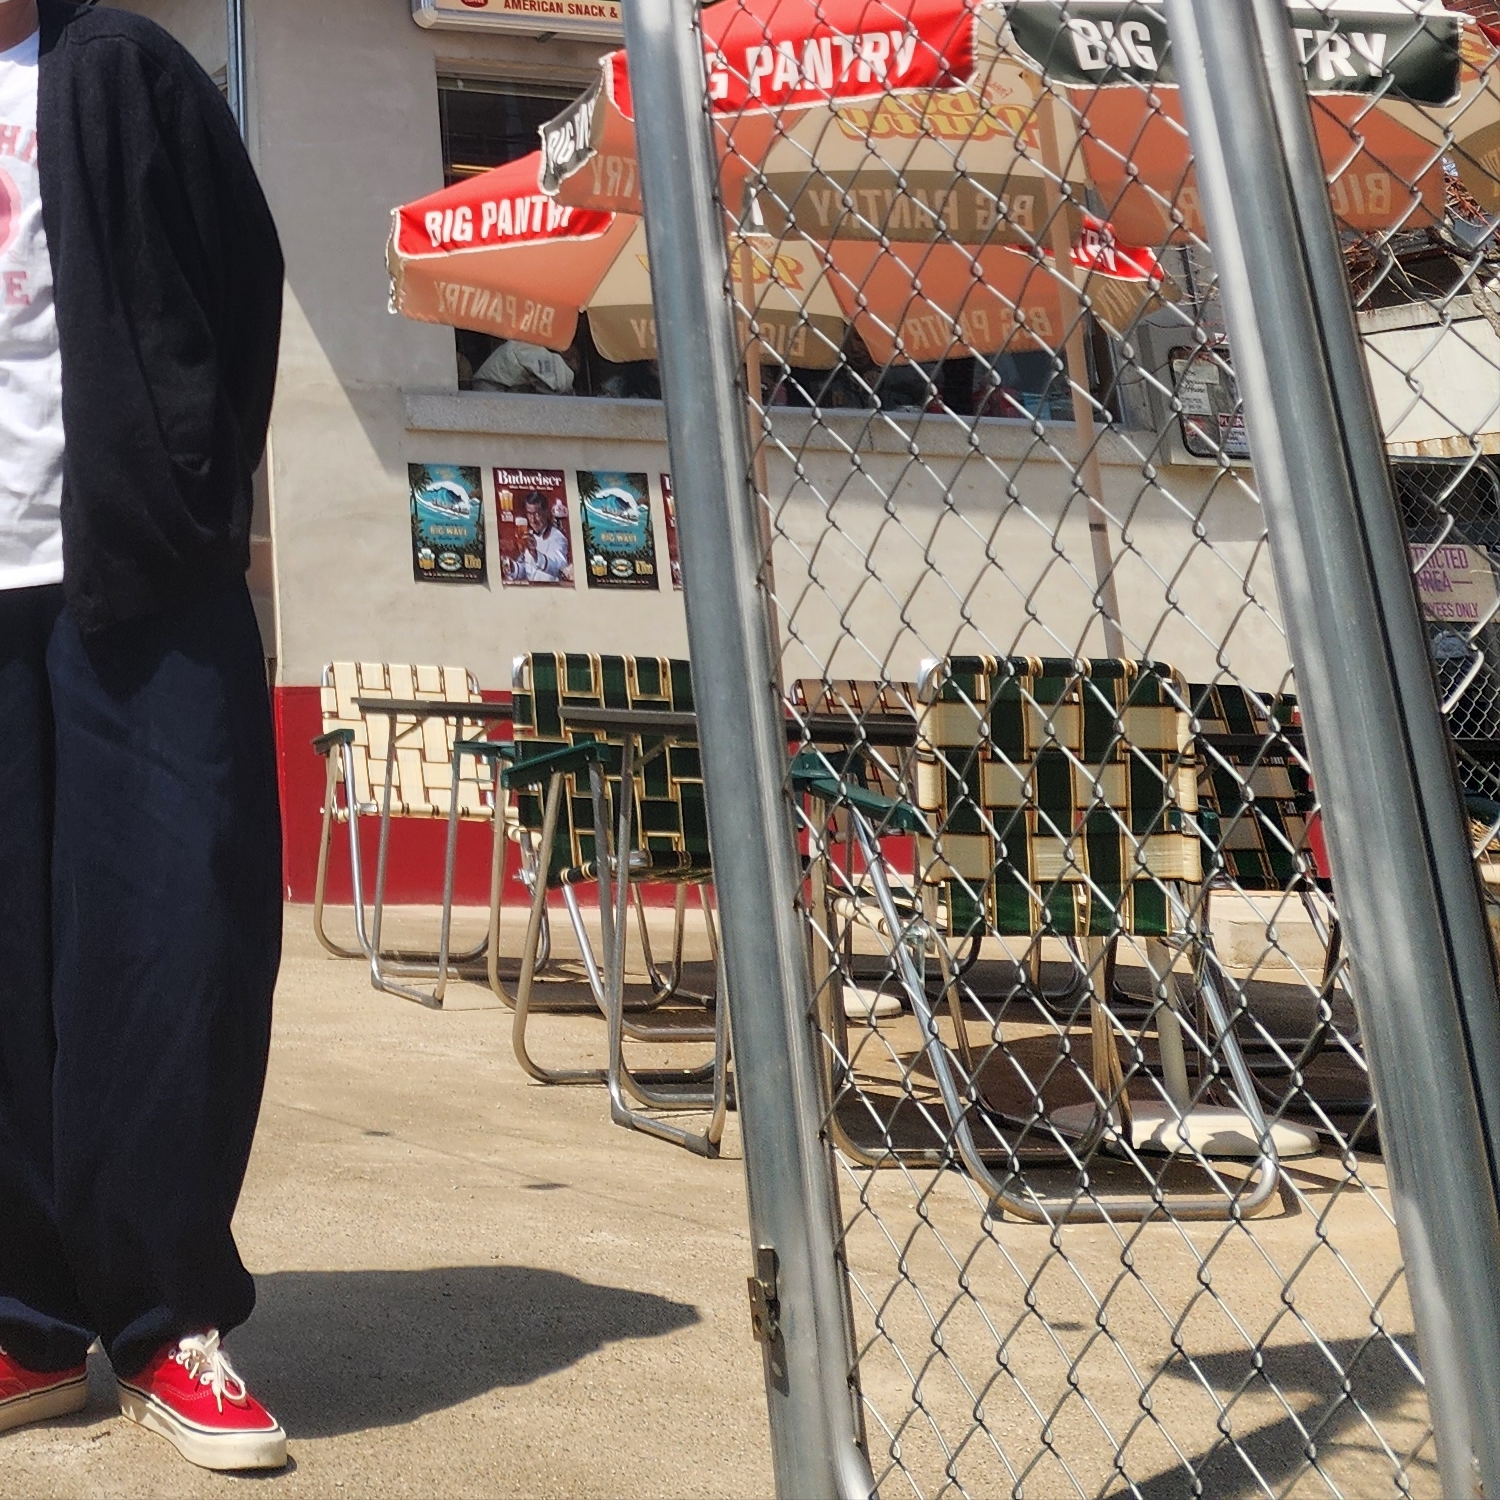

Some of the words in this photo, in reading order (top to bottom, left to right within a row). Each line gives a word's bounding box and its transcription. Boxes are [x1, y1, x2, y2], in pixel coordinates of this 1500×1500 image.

[567, 3, 606, 17] SNACK
[609, 7, 618, 19] &
[1070, 18, 1158, 71] BIG
[1297, 28, 1387, 82] TRY
[746, 29, 919, 95] PANTRY
[424, 205, 473, 248] BIG
[497, 469, 562, 487] Budweiser
[1411, 547, 1469, 569] TRICTED
[1455, 603, 1479, 618] ONLY
